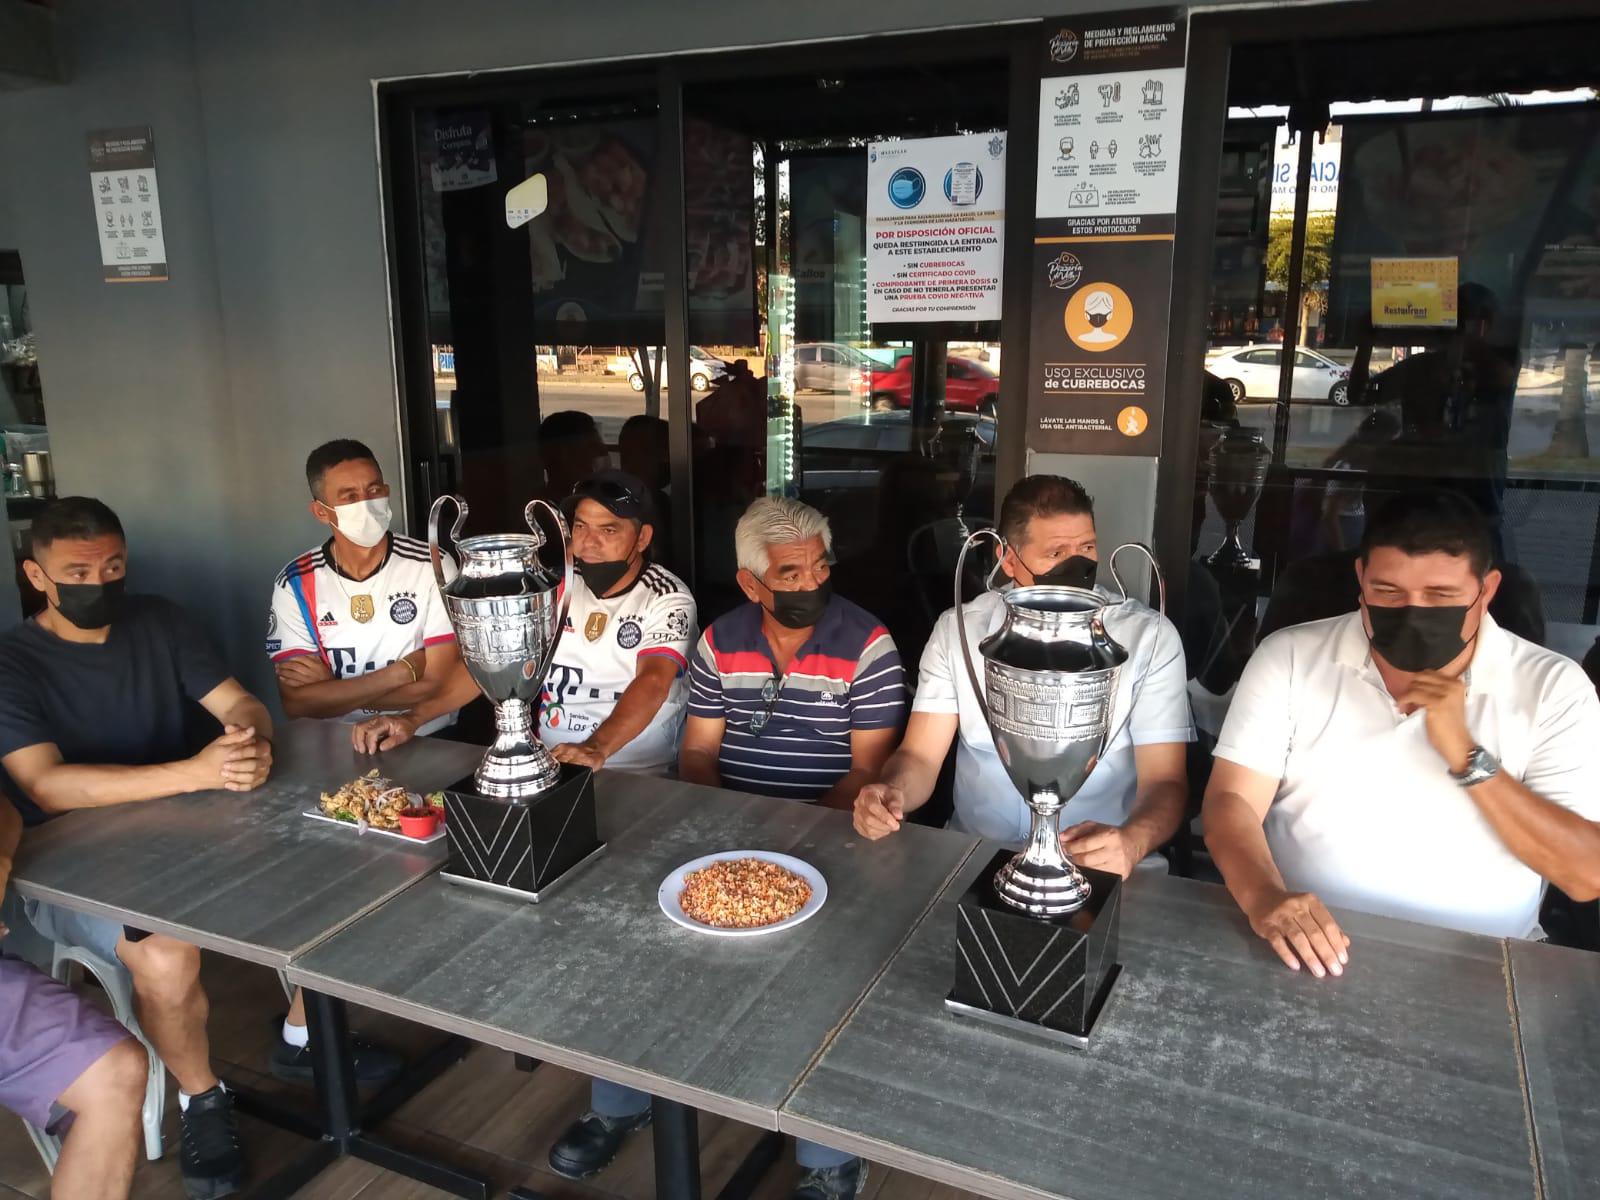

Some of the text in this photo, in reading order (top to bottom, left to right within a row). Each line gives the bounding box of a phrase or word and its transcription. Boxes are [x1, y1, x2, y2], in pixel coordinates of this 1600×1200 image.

[1084, 22, 1176, 39] MEDIDAS Y REGLAMENTOS
[1084, 32, 1168, 48] DE PROTECCIÓN BÁSICA.
[1067, 216, 1141, 226] GRACIAS POR ATENDER
[876, 226, 995, 240] POR DISPOSICIÓN OFICIAL
[1072, 225, 1137, 234] ESTOS PROTOCOLOS
[873, 237, 998, 250] QUEDA RESTRINGIDA LA ENTRADA
[913, 245, 982, 255] ESTABLECIMIENTO
[919, 260, 965, 269] CUBREBOCAS
[908, 270, 953, 278] CERTIFICADO
[954, 269, 976, 277] COVID
[938, 279, 968, 287] PRIMERA
[956, 284, 996, 292] PRESENTAR
[950, 291, 984, 299] NEGATIVA
[935, 304, 976, 312] COMPRENSIÓN
[1044, 367, 1145, 379] USO EXCLUSIVO
[1044, 378, 1146, 390] de CUBREBOCAS
[1040, 416, 1064, 424] LÁVATE
[568, 718, 587, 731] Los
